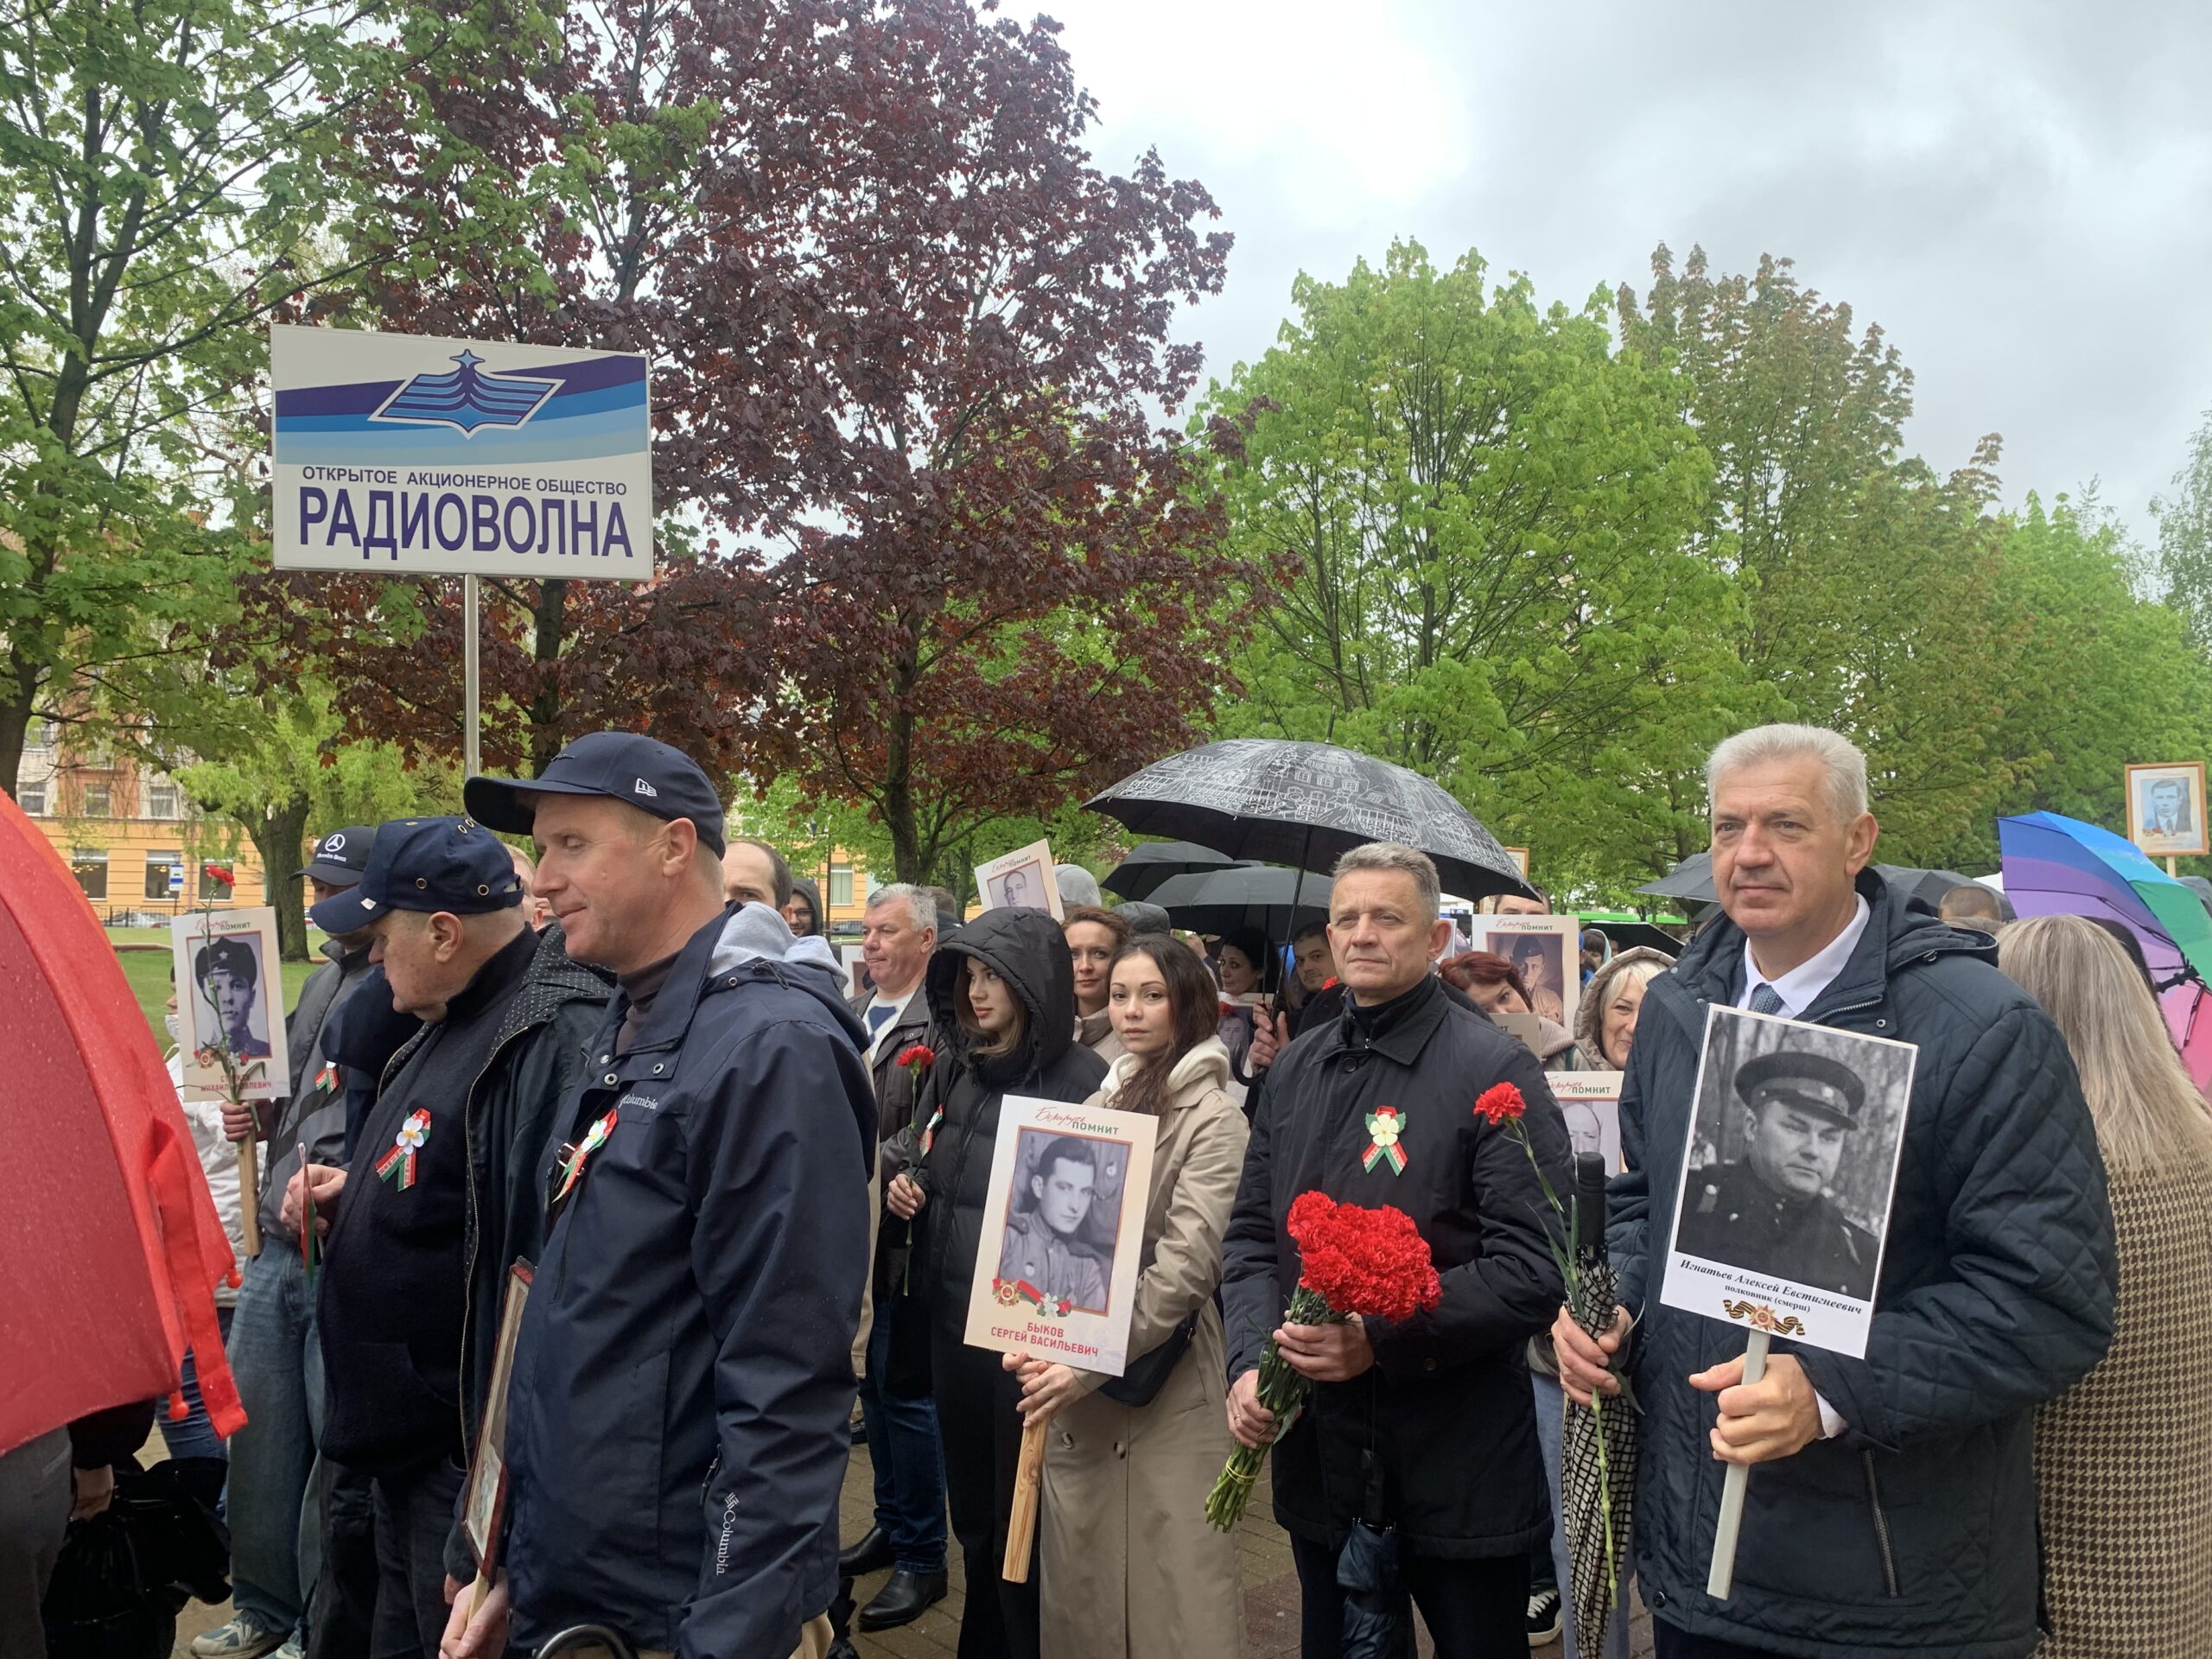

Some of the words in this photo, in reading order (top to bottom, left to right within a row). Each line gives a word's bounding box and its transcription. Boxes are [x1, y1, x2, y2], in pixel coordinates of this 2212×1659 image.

[302, 466, 397, 485] ОТКРЫТОЕ
[406, 471, 531, 491] АКЦИОНЕРНОЕ
[536, 478, 627, 496] ОБЩЕСТВО
[299, 486, 633, 561] РАДИОВОЛНА
[219, 921, 251, 931] ПОМНИТ
[1035, 1106, 1087, 1126] Беларусь
[1071, 1121, 1120, 1135] ПОМНИТ
[1680, 1259, 1733, 1281] Игнатьев
[1734, 1274, 1780, 1294] Алексей
[1782, 1284, 1863, 1315] Евстигнеевич
[1725, 1284, 1773, 1303] полковник
[1774, 1297, 1811, 1313] (смерш)
[990, 1326, 1027, 1343] СЕРГЕЙ
[1030, 1334, 1099, 1357] ВАСИЛЬЕВИЧ
[1027, 1322, 1065, 1338] БЫКОВ
[715, 1510, 736, 1576] Columbia
